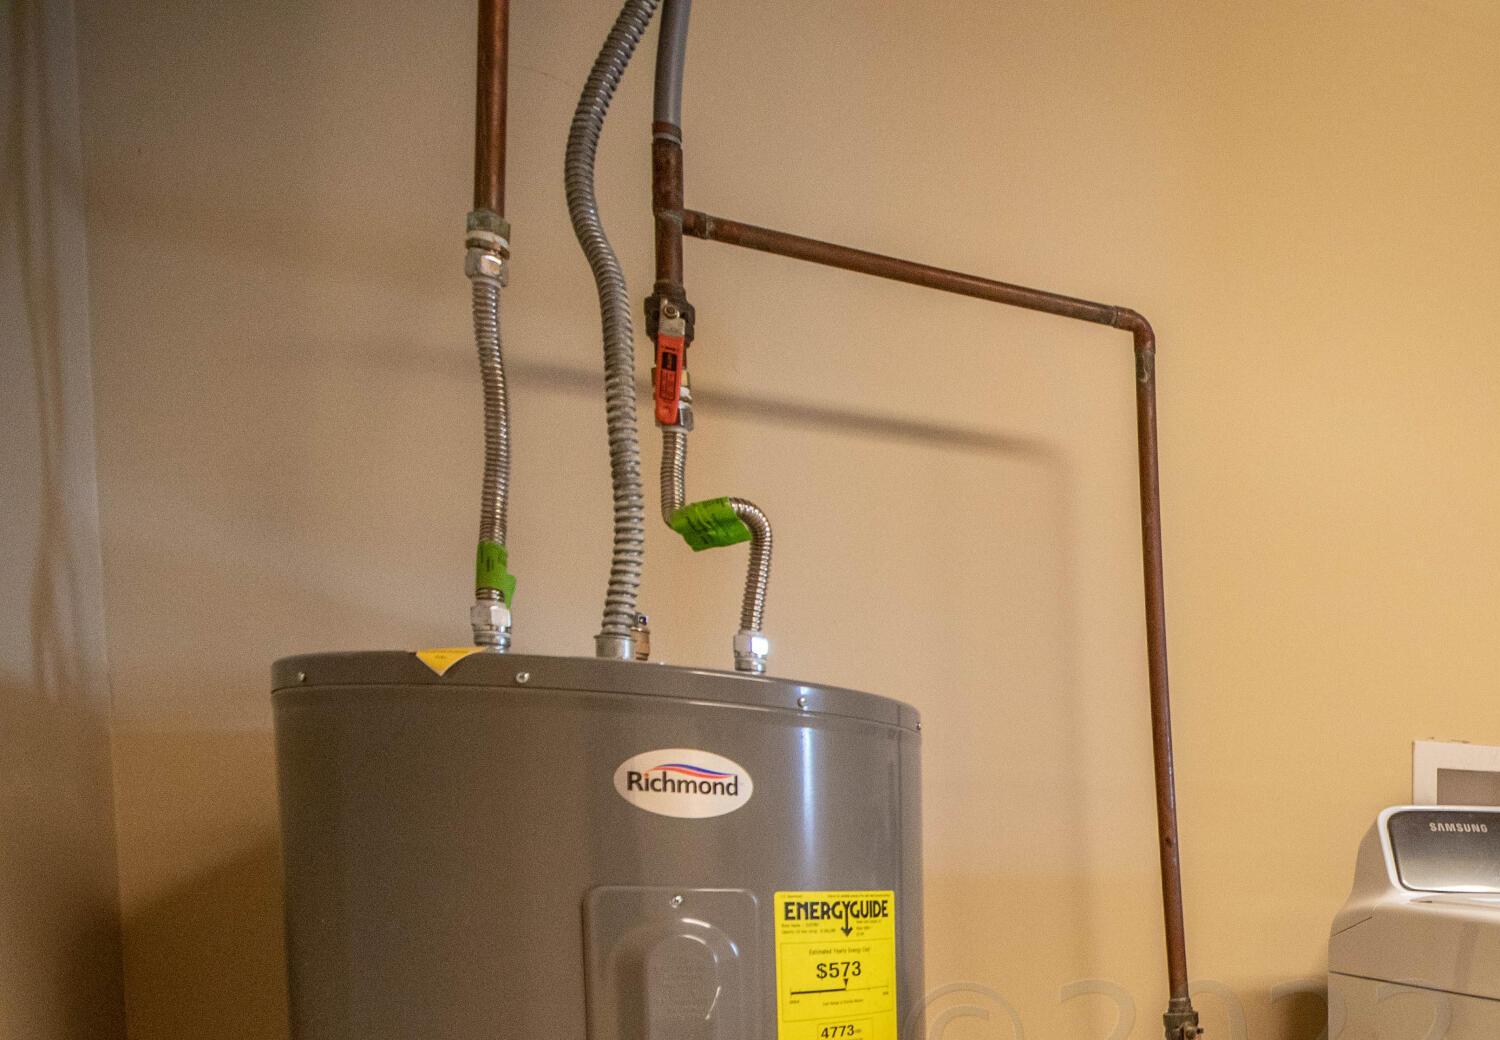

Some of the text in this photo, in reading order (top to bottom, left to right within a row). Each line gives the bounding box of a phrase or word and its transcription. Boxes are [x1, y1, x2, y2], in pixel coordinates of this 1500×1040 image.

[627, 770, 738, 796] Richmond
[1429, 822, 1488, 833] SAMSUNG
[784, 900, 888, 921] ENERGYGUIDE
[816, 961, 861, 979] $573
[821, 1024, 855, 1039] 4773
